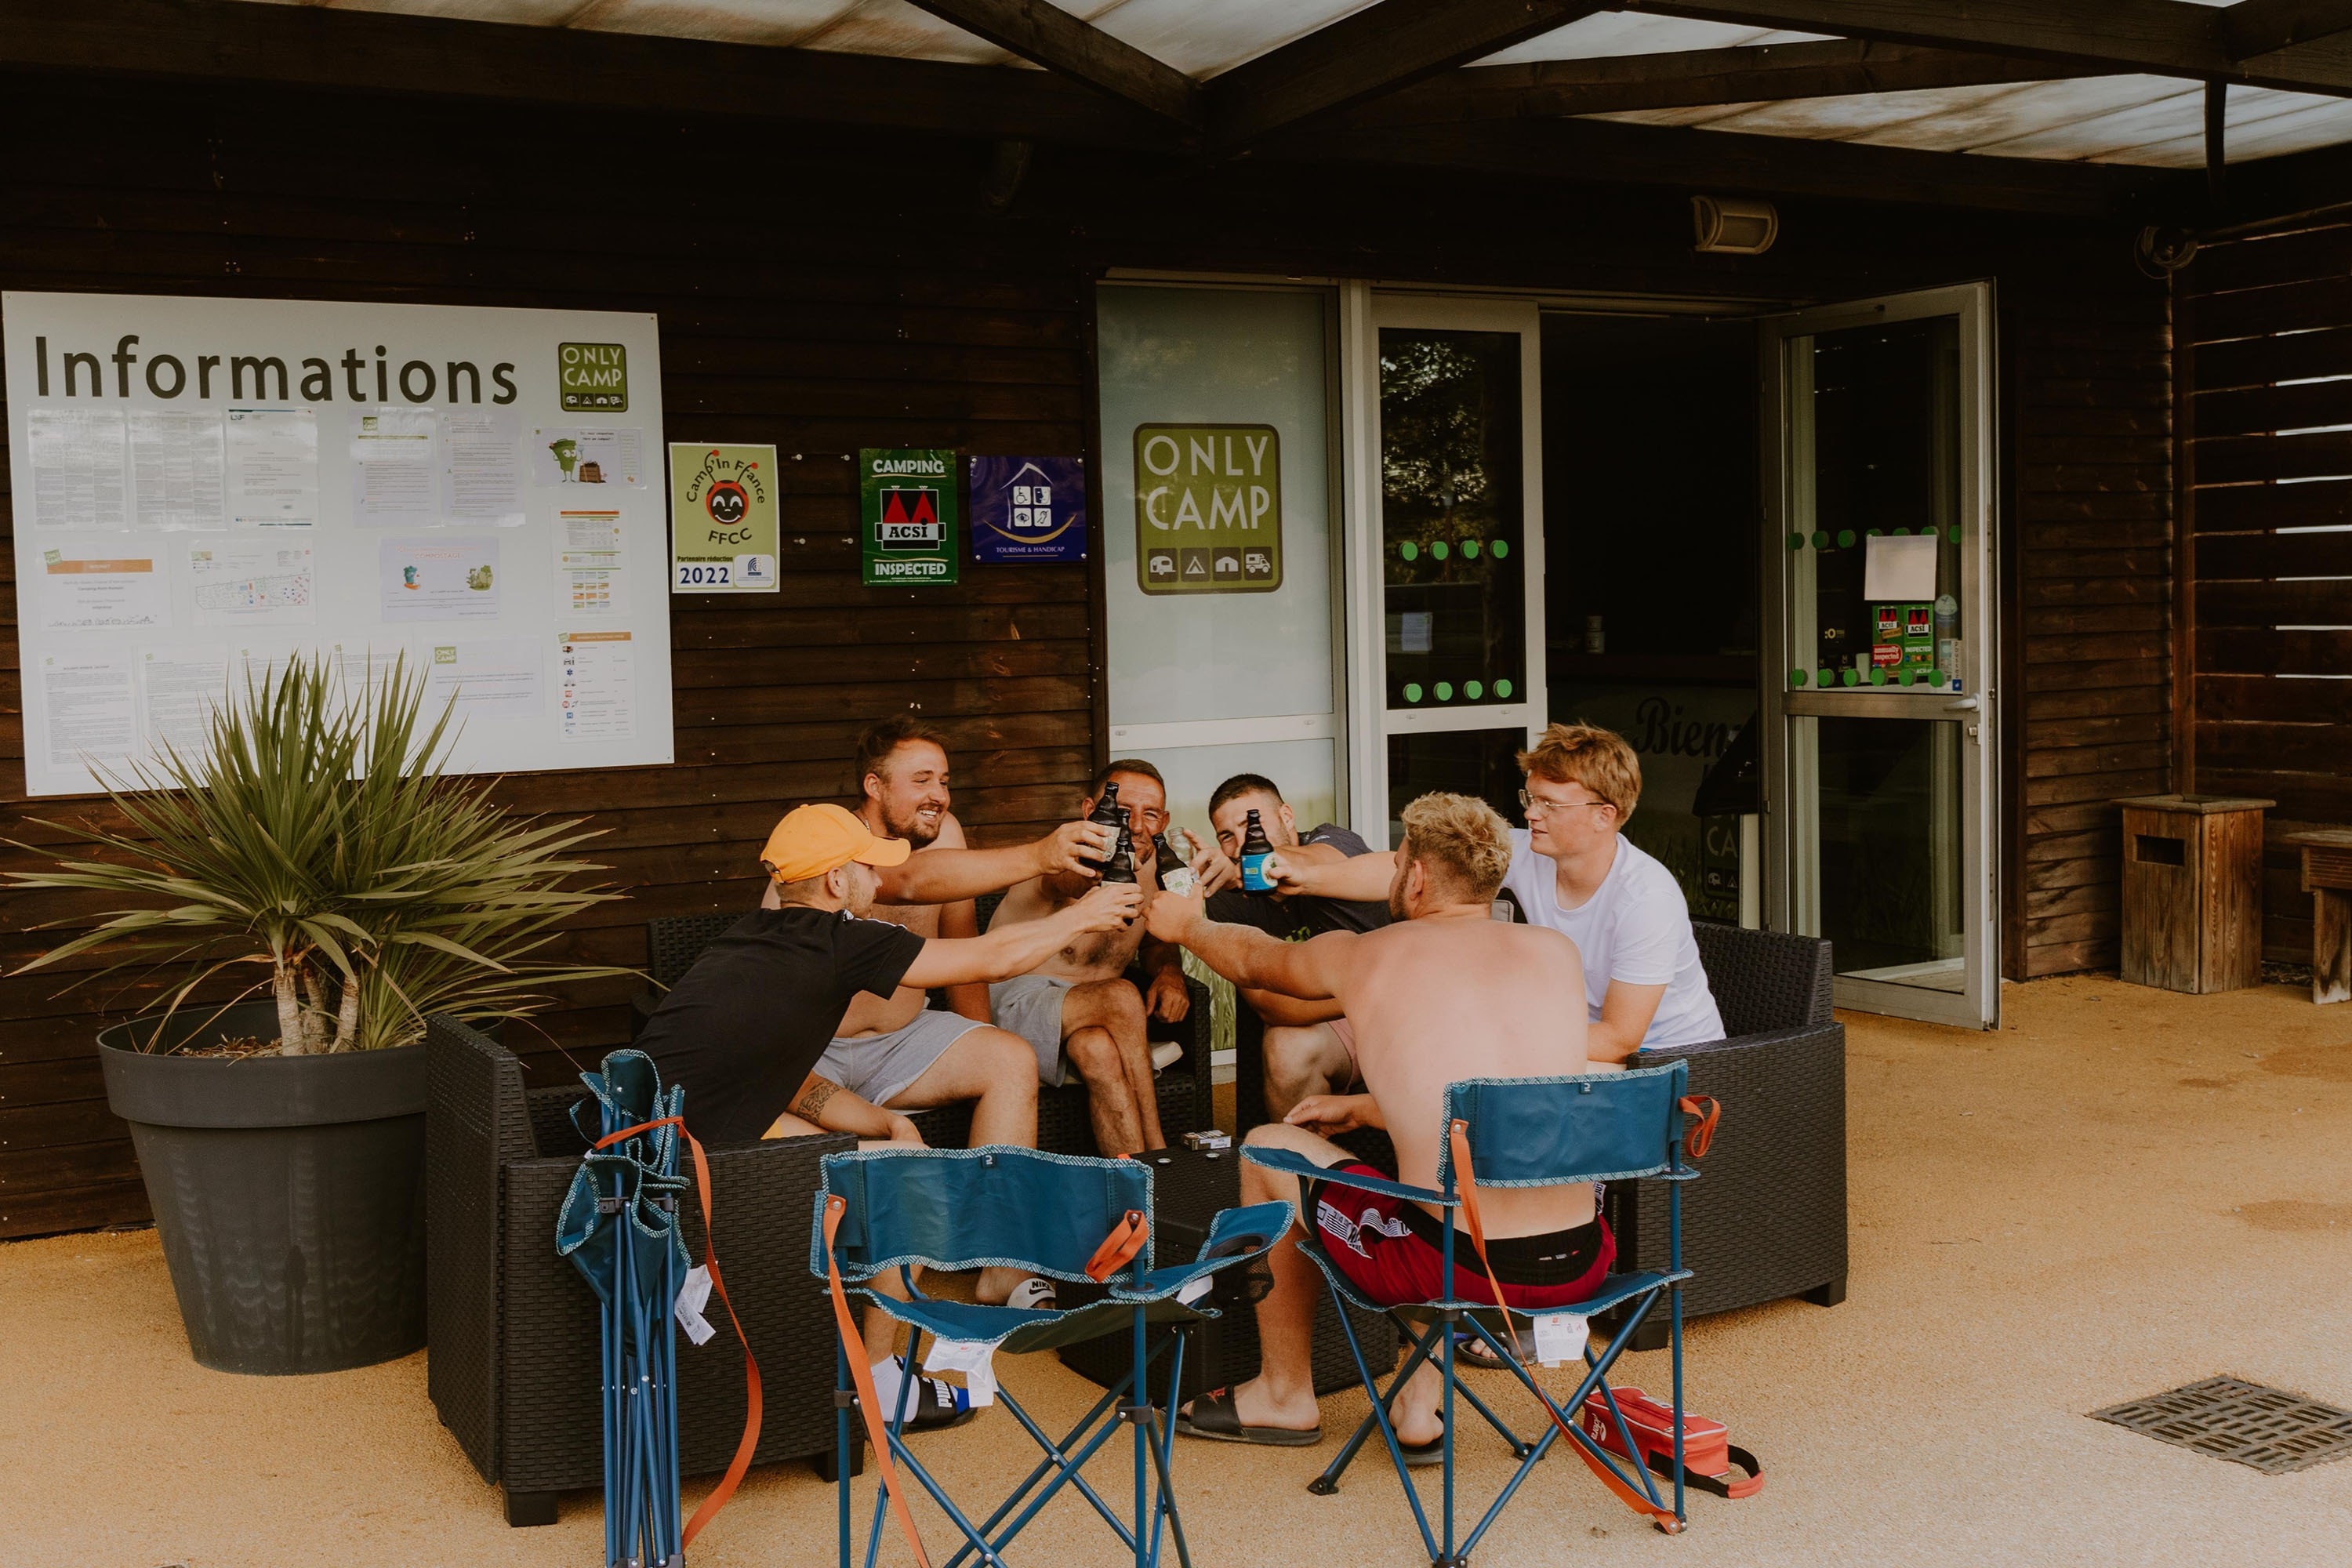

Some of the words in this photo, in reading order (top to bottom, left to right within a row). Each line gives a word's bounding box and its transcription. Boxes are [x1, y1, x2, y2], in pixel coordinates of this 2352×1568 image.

[563, 347, 622, 365] ONLY
[35, 335, 517, 405] Informations
[564, 367, 622, 387] CAMP
[1144, 435, 1269, 476] ONLY
[873, 459, 945, 474] CAMPING
[1145, 485, 1270, 530] CAMP
[708, 528, 752, 544] FFCC
[680, 567, 729, 584] 2022
[875, 563, 947, 575] INSPECTED
